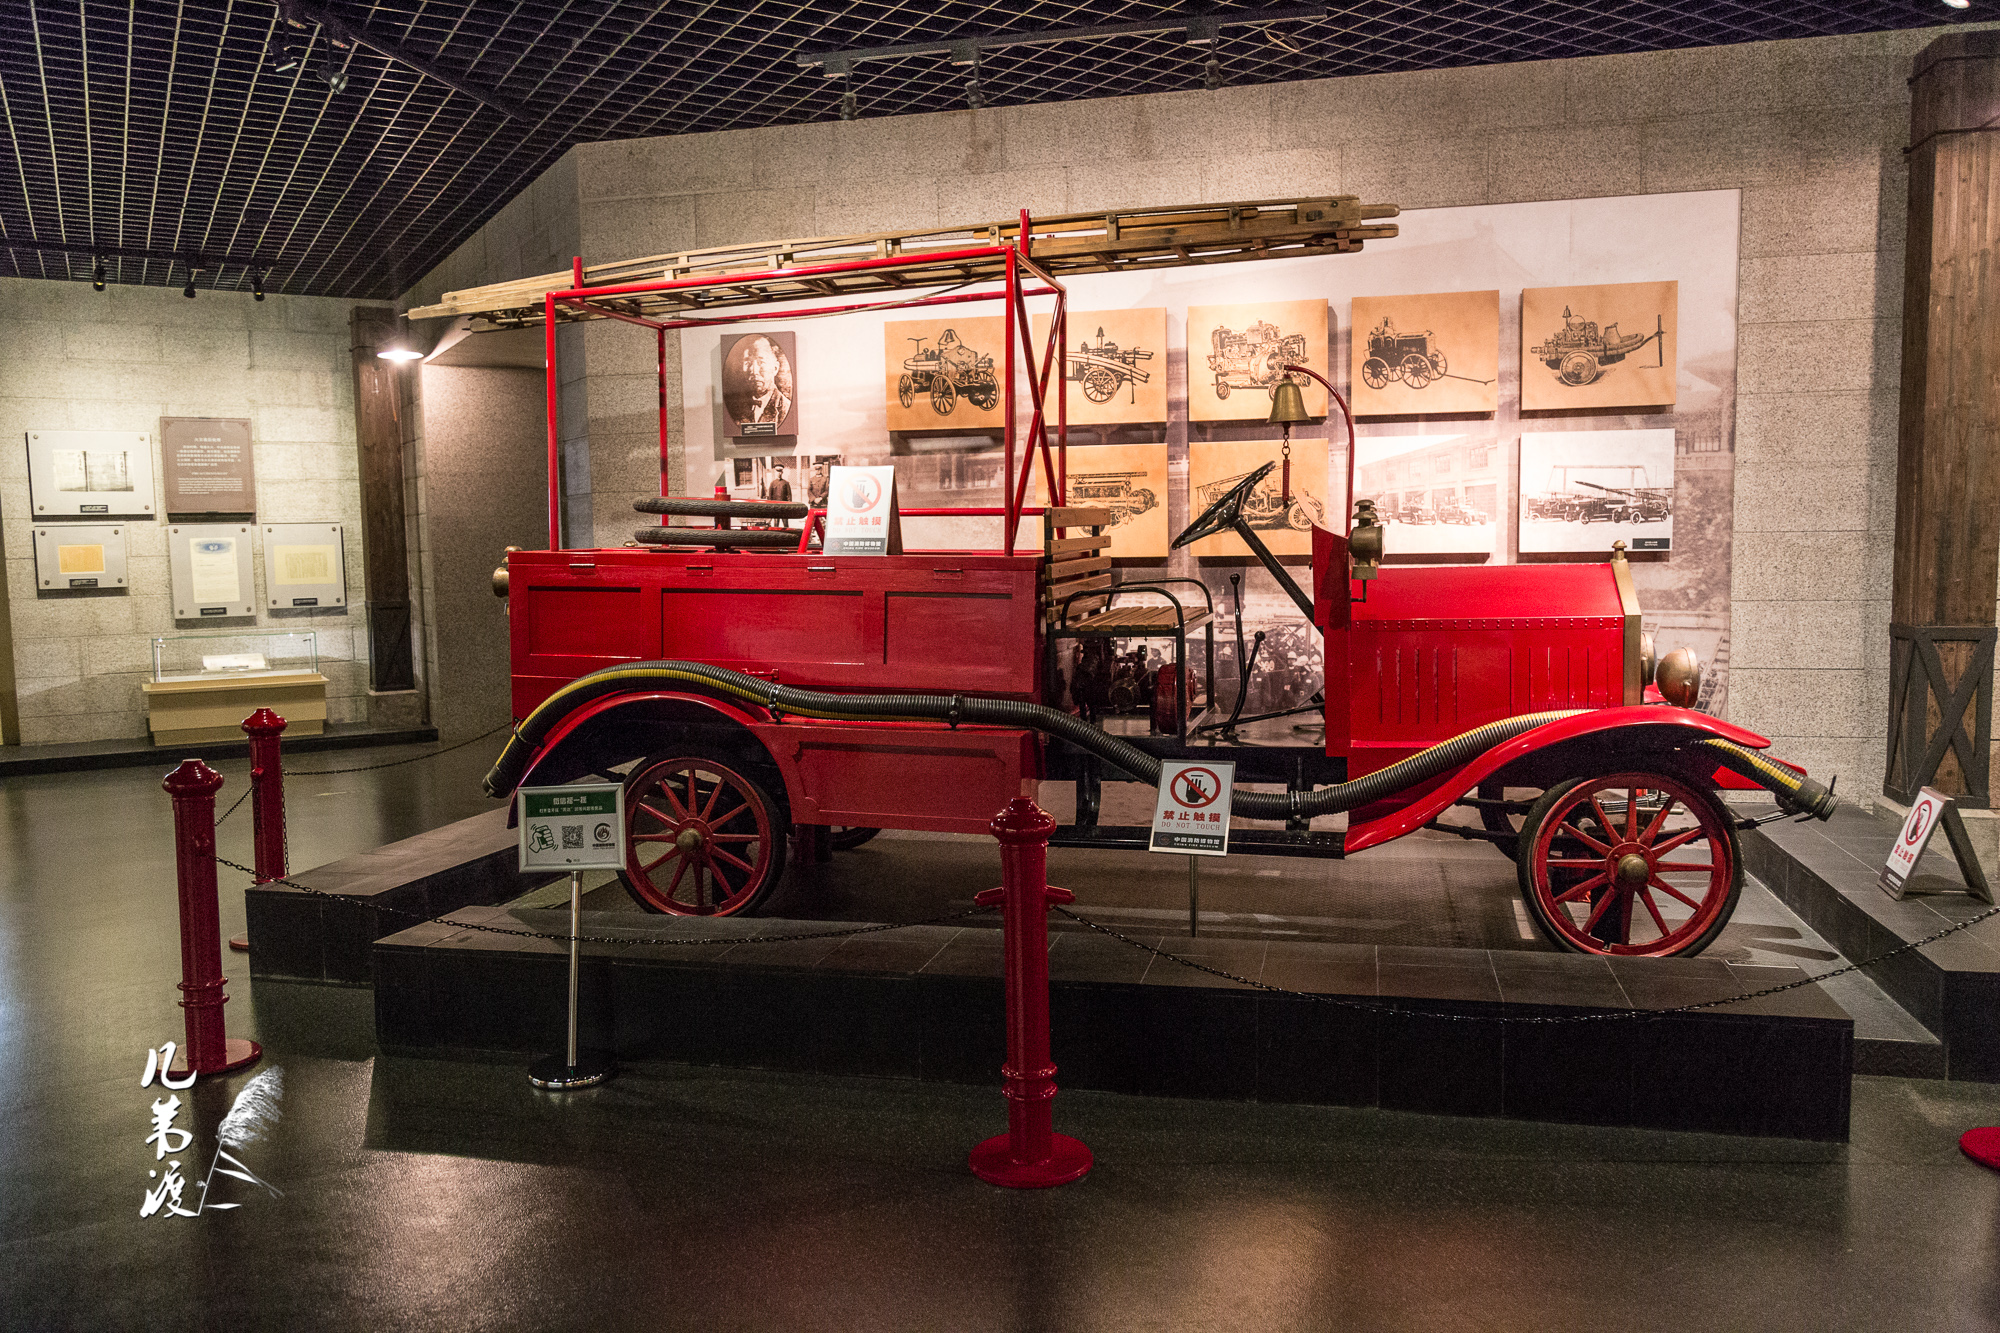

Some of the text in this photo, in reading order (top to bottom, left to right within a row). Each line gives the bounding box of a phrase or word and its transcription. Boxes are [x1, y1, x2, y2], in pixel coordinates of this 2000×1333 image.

[833, 517, 882, 525] 禁止触摸
[1163, 810, 1221, 822] 禁止触摸
[1196, 823, 1220, 831] TOUCH
[1174, 836, 1220, 844] 中国消防博物馆
